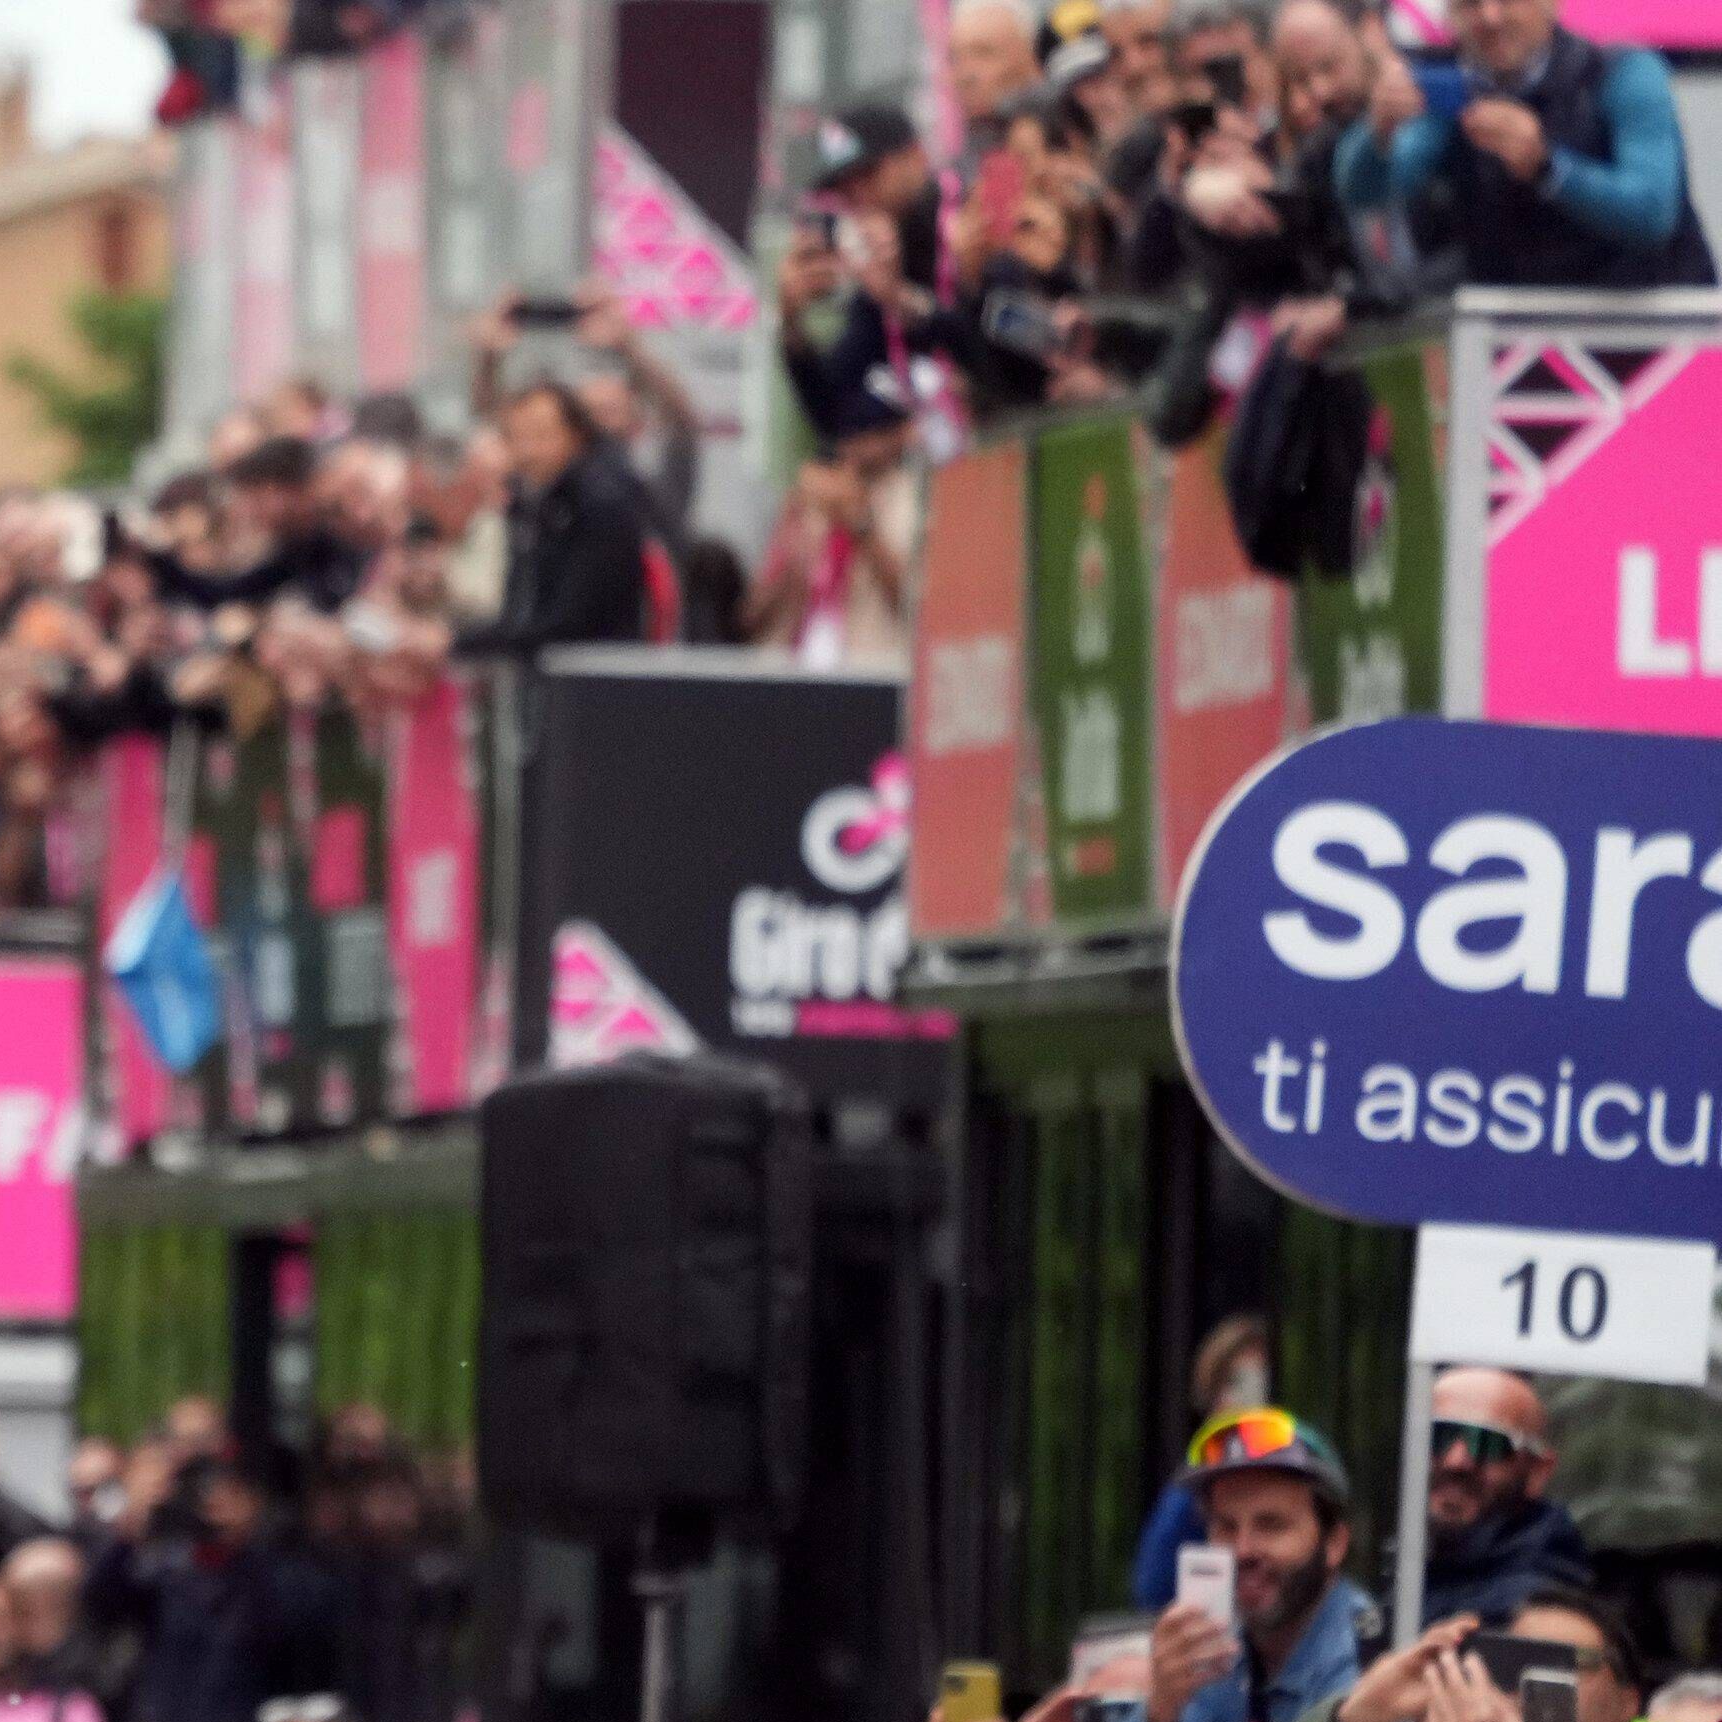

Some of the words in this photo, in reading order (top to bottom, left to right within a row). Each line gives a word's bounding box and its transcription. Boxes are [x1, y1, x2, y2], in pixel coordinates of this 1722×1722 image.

[1253, 1038, 1328, 1135] ti
[1354, 1059, 1722, 1168] assicu
[1499, 1257, 1610, 1345] 10
